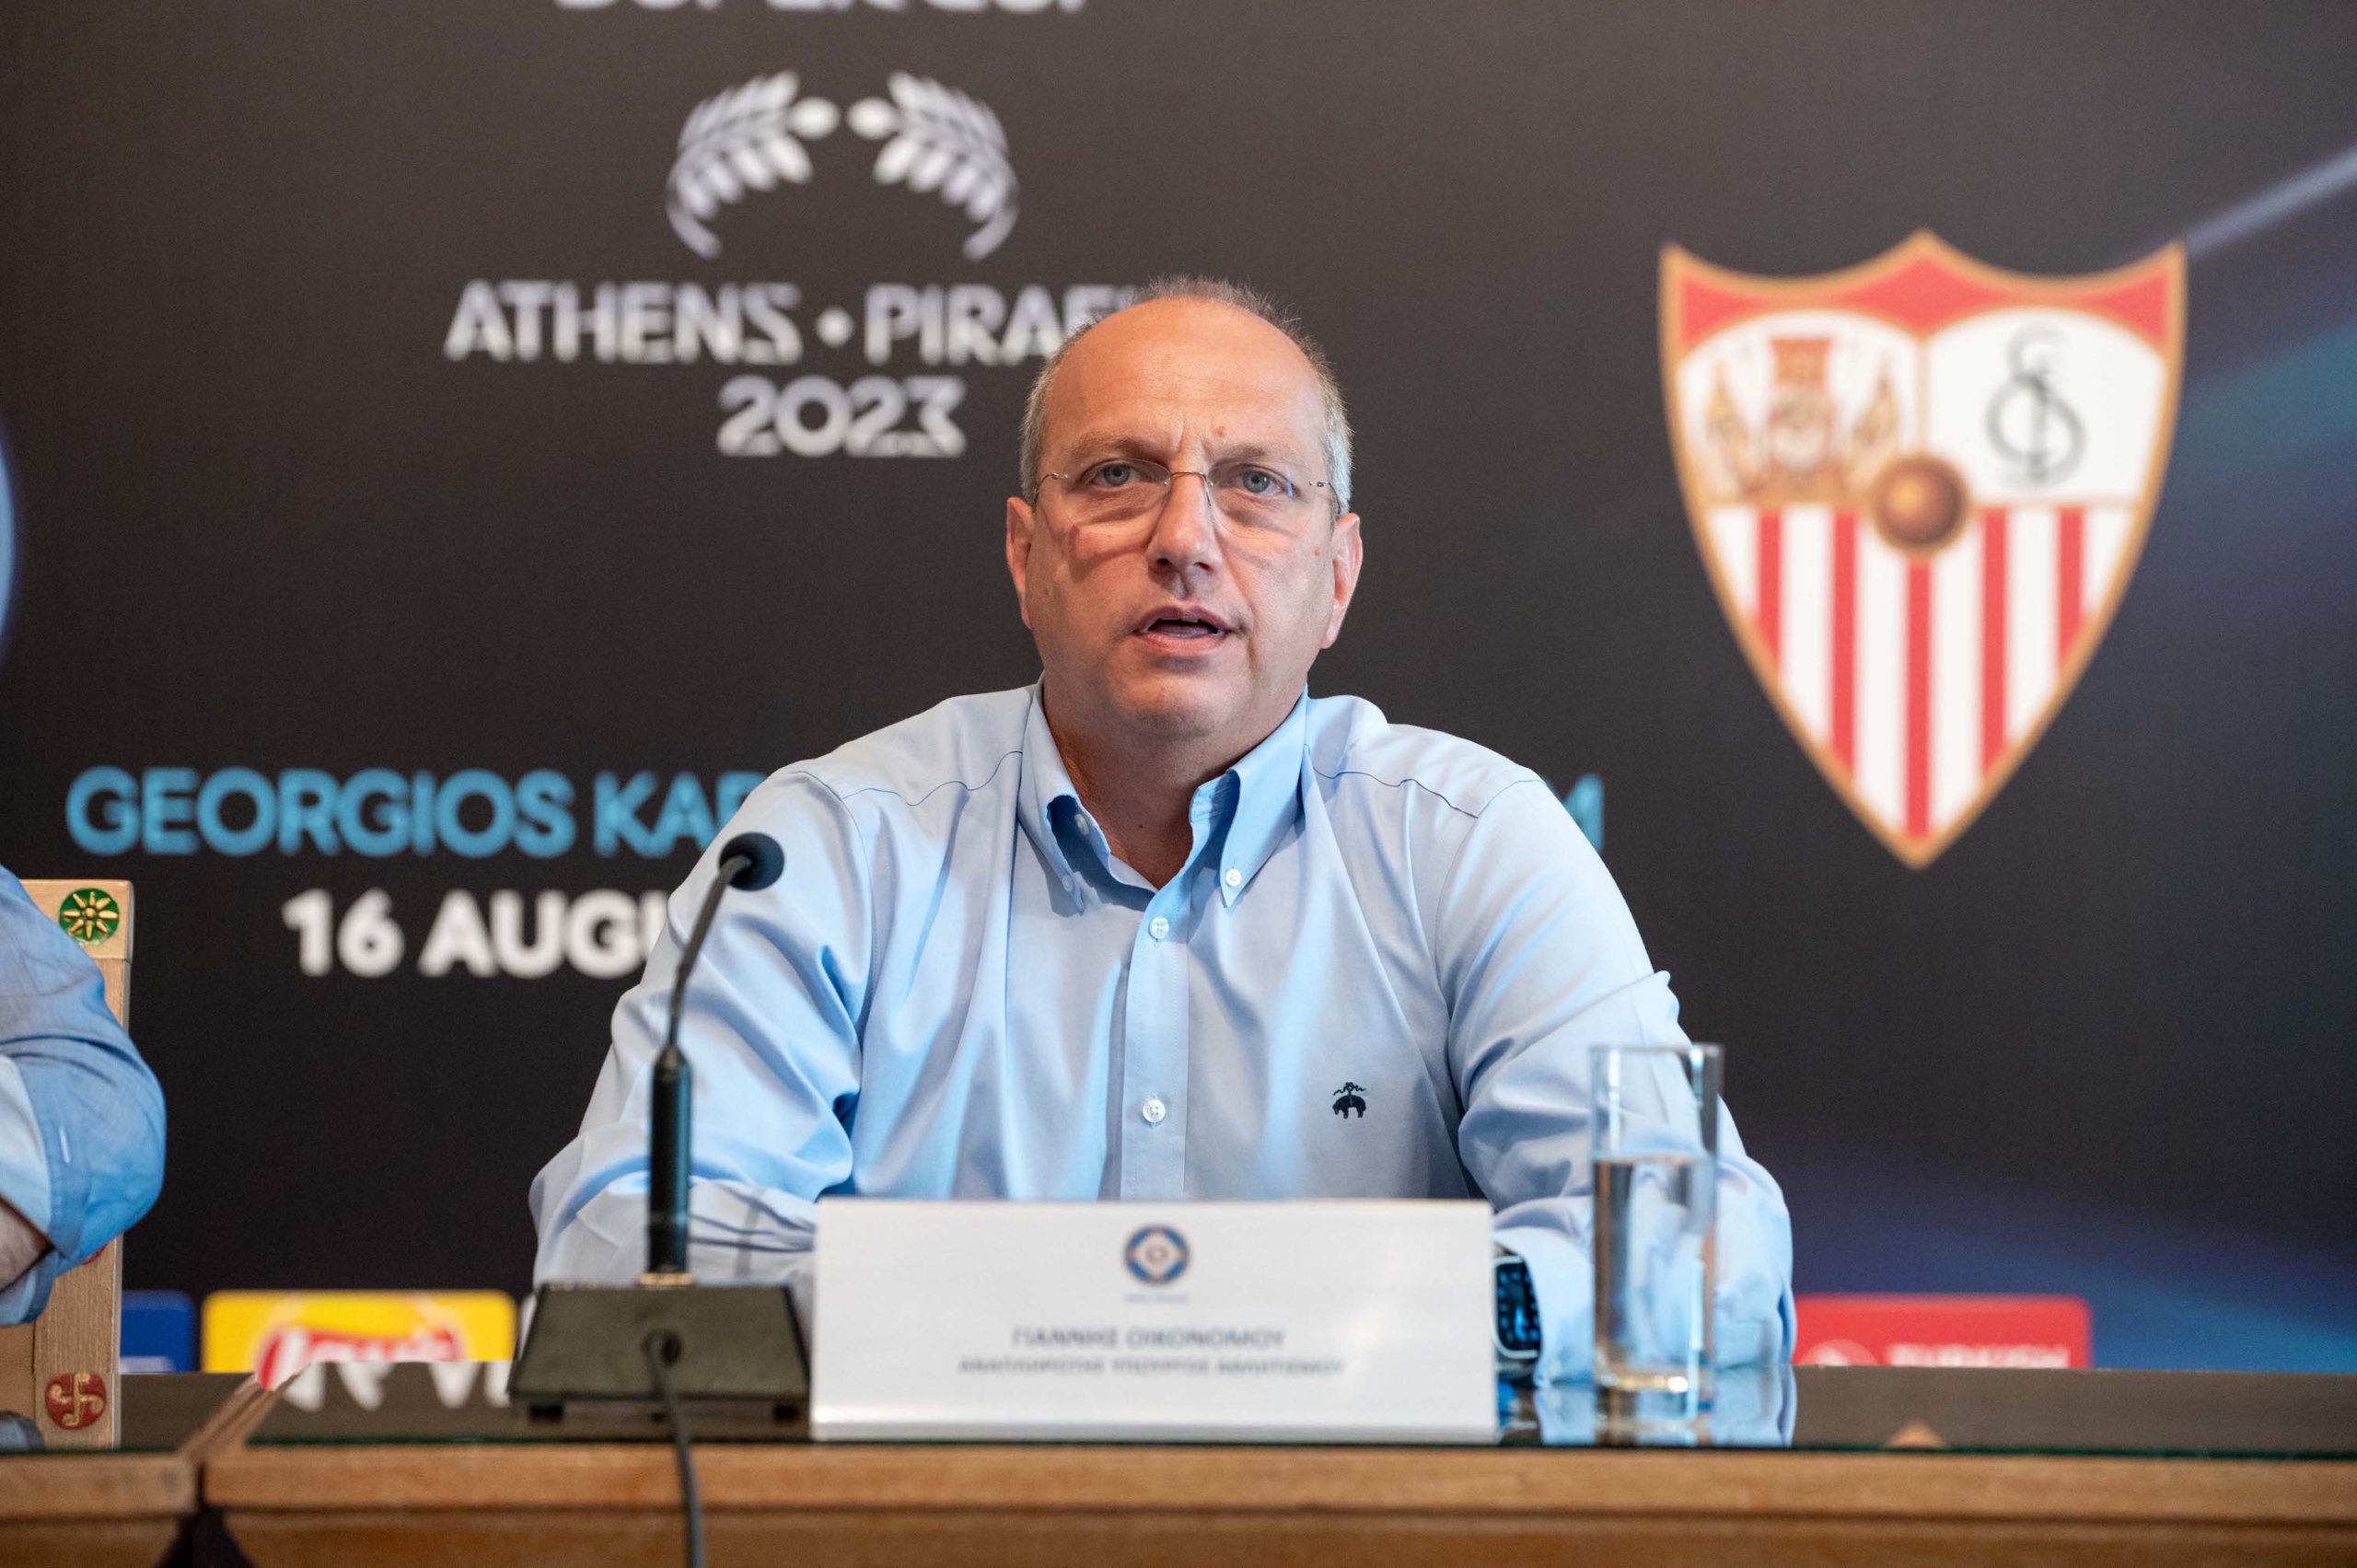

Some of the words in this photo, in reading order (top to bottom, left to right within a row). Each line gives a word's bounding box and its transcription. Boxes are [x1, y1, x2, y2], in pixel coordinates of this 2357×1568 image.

[443, 280, 803, 363] ATHENS
[865, 284, 1136, 366] PIRA
[716, 375, 967, 459] 2023
[65, 765, 576, 857] GEORGIOS
[282, 889, 405, 977] 16
